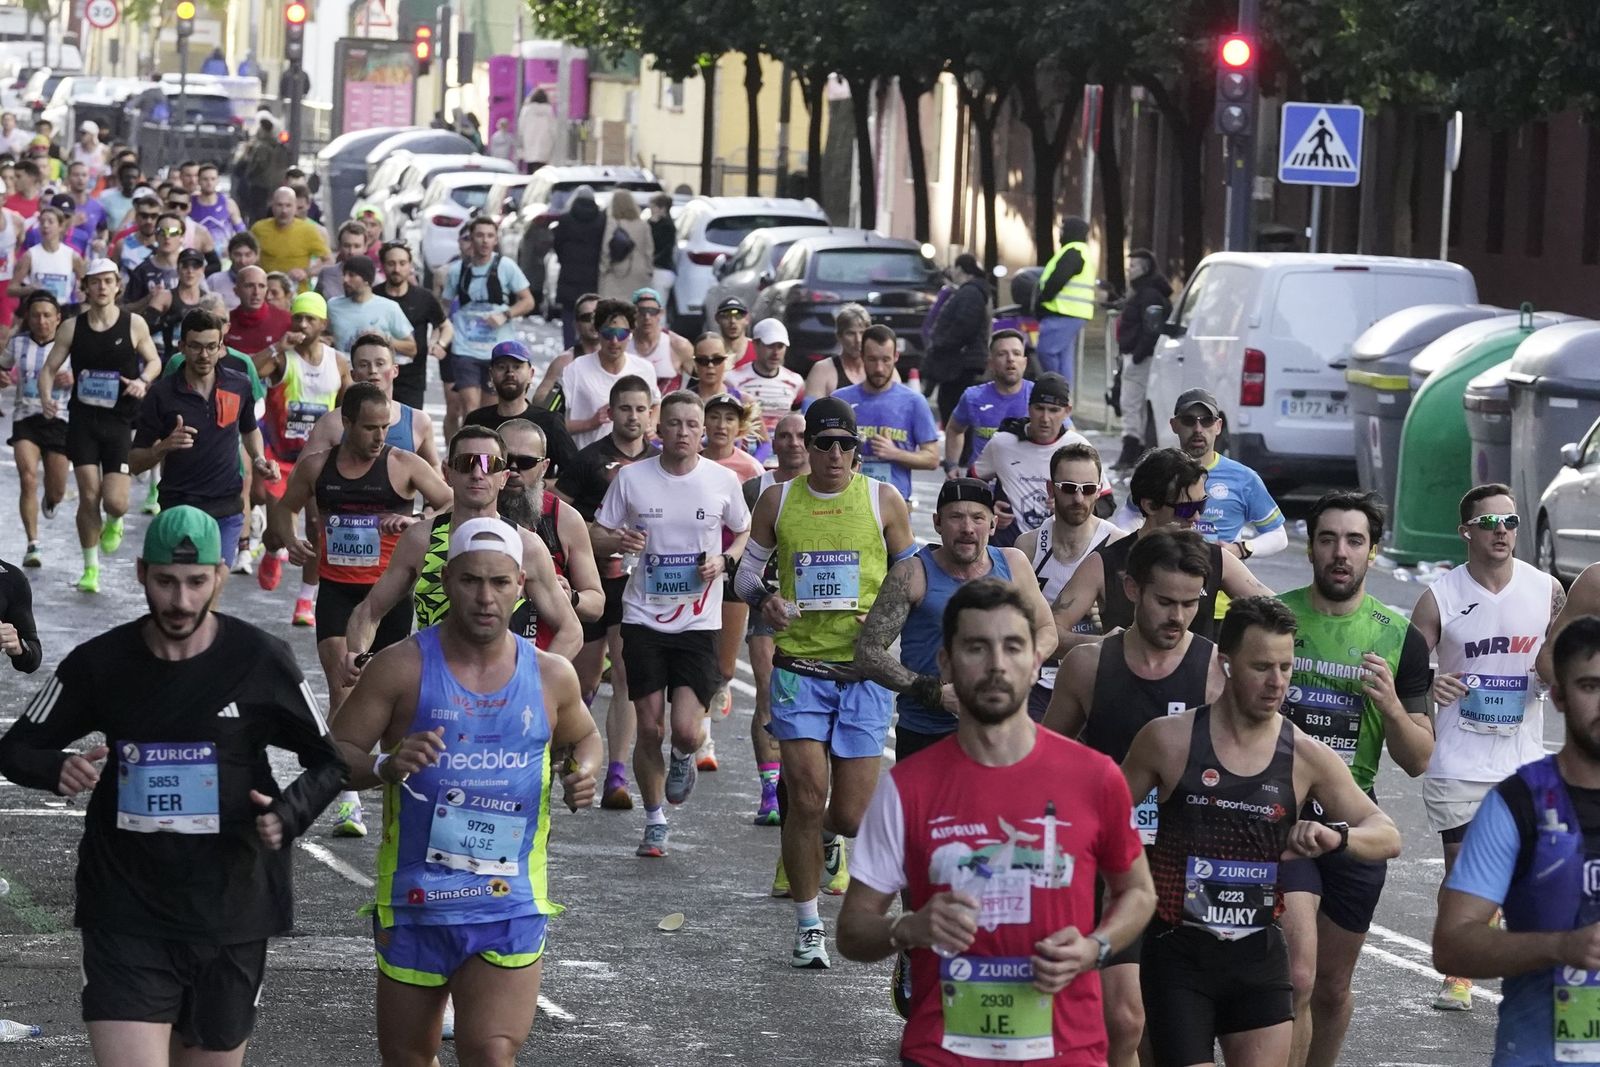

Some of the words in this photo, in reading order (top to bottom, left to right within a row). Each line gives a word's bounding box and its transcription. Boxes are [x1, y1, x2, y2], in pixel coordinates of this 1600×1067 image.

[1290, 401, 1321, 413] 9177
[343, 518, 374, 526] ZURICH
[332, 542, 374, 555] PALACIO
[663, 555, 696, 565] ZURICH
[815, 554, 852, 563] ZURICH
[664, 571, 682, 579] 9315
[816, 572, 836, 581] 6274
[656, 582, 690, 593] PAWEL
[812, 583, 842, 597] FEDE
[1371, 610, 1392, 625] 2023
[1464, 635, 1539, 659] MRW
[1485, 679, 1521, 688] ZURICH
[1308, 691, 1354, 706] ZURICH
[1484, 696, 1504, 705] 9141
[430, 708, 459, 721] GOBIK
[1305, 714, 1332, 727] 5313
[1460, 708, 1495, 722] CARLITOS
[145, 748, 204, 761] ZURICH
[148, 775, 180, 788] 5853
[147, 793, 183, 812] FER
[1186, 794, 1209, 806] Club
[467, 819, 495, 835] 9729
[459, 835, 495, 851] JOSE
[1218, 866, 1267, 879] ZURICH
[427, 886, 482, 901] SimaGol
[1218, 890, 1245, 903] 4223
[1202, 905, 1256, 925] JUAKY
[980, 994, 1014, 1007] 2930
[980, 1014, 1016, 1034] J.E.
[1556, 1018, 1576, 1039] A.
